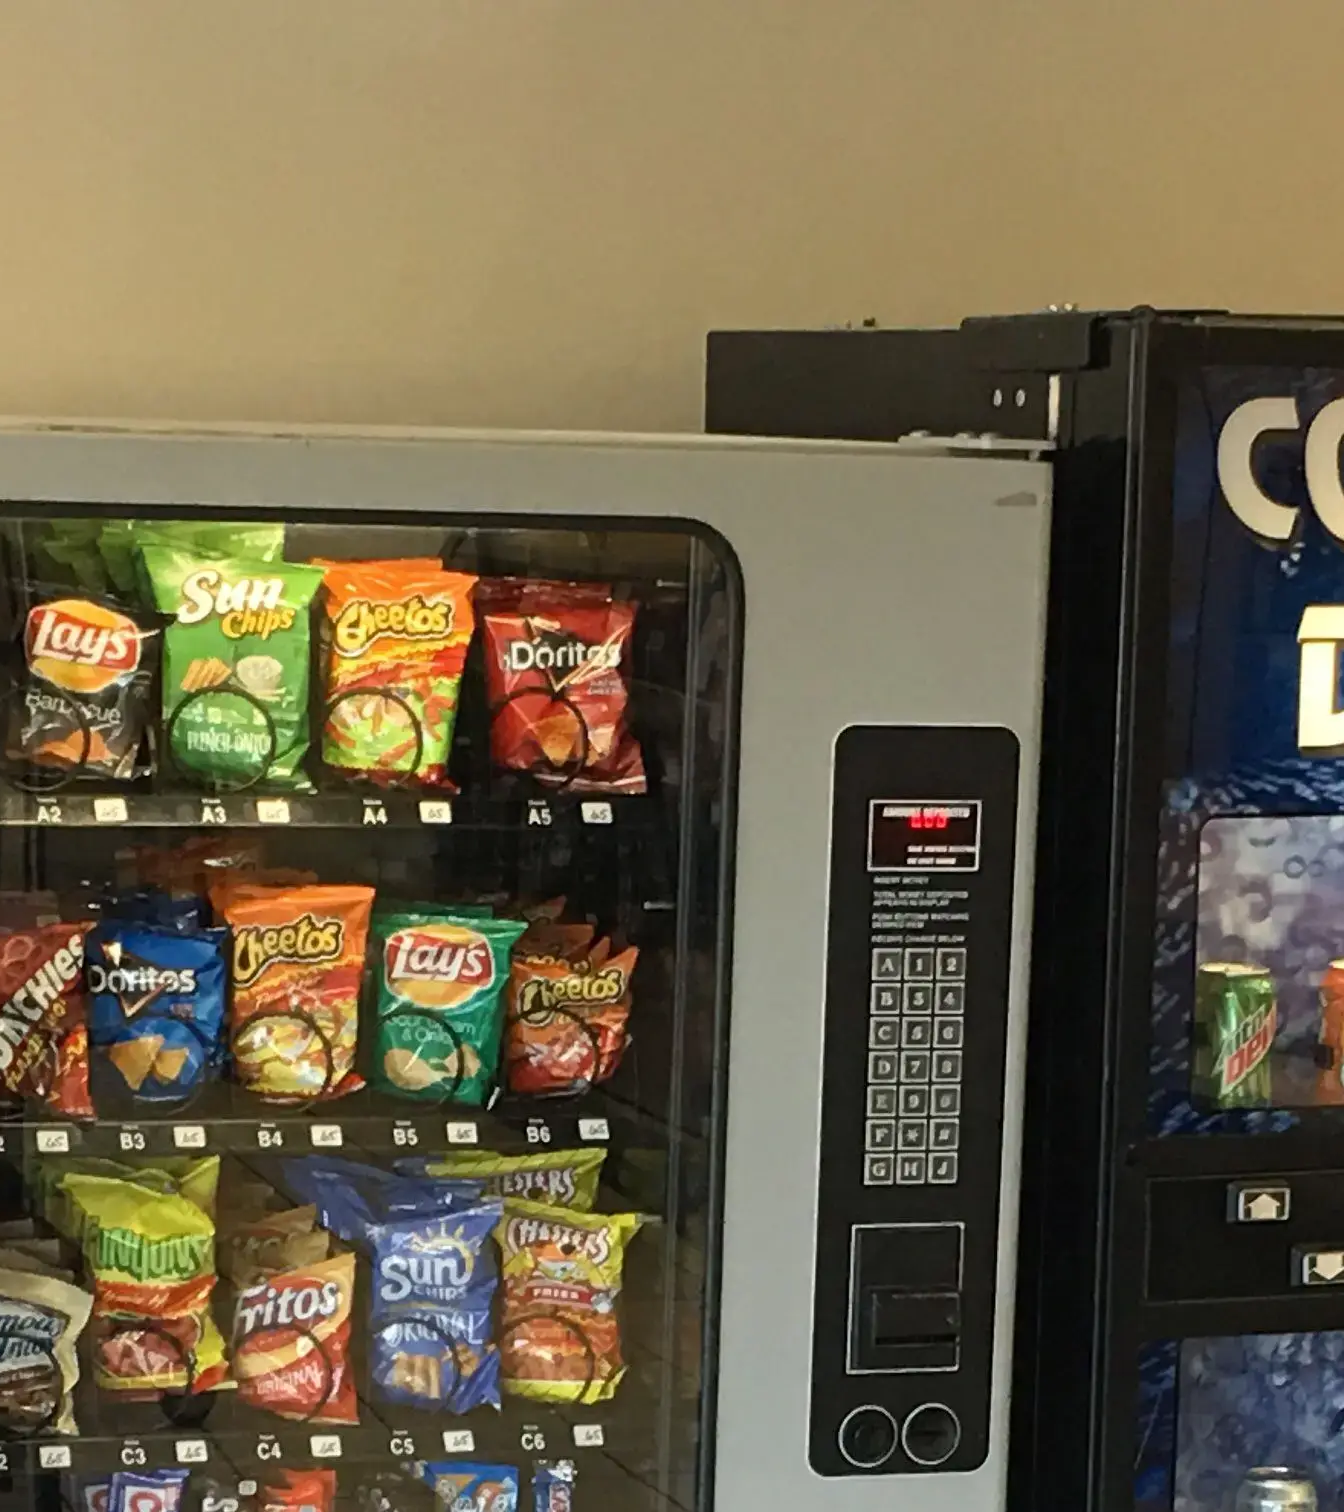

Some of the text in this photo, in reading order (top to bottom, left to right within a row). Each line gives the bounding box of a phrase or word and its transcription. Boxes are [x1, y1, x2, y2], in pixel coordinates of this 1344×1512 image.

[177, 570, 285, 624] Sun
[222, 604, 295, 640] Chips
[336, 598, 452, 653] Cheetos
[511, 640, 622, 669] Doritos
[37, 806, 62, 824] A2
[202, 806, 227, 824] A3
[362, 807, 387, 825] A4
[528, 808, 552, 826] A5
[235, 916, 340, 979] Cheetos
[881, 959, 894, 972] A
[916, 959, 923, 971] 1
[947, 958, 957, 972] 2
[89, 966, 196, 993] Doritos
[522, 969, 620, 1020] Cheetos
[881, 993, 893, 1006] B
[944, 993, 955, 1006] 4
[879, 1026, 892, 1040] C
[943, 1026, 954, 1040] 6
[878, 1061, 891, 1074] D
[911, 1061, 920, 1074] 7
[120, 1133, 146, 1150] B3
[257, 1130, 283, 1148] B4
[393, 1128, 418, 1146] B5
[526, 1126, 551, 1143] B6
[872, 1163, 885, 1177] G
[903, 1162, 918, 1176] H
[937, 1161, 947, 1175] J
[381, 1254, 472, 1301] Sun
[389, 1437, 415, 1455] C5
[520, 1432, 545, 1450] C6
[121, 1448, 147, 1466] C3
[256, 1443, 282, 1460] C4
